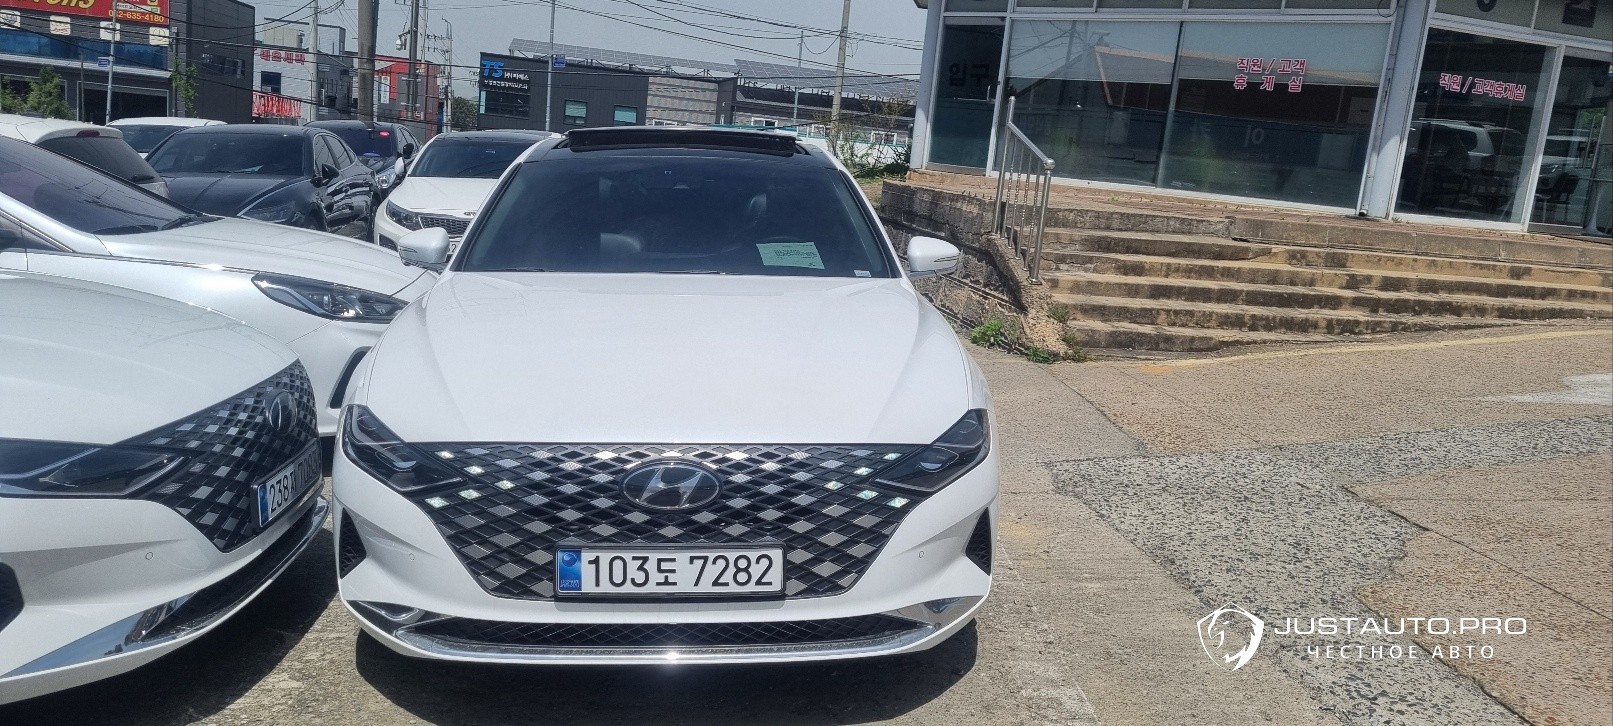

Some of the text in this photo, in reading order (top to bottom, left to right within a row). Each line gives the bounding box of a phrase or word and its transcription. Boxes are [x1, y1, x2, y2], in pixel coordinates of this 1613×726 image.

[109, 9, 165, 22] 02-635-4180
[481, 60, 505, 78] TS
[1237, 58, 1307, 75] 직원 / 고객
[1440, 73, 1463, 92] 직원
[587, 553, 774, 588] 103도 7282
